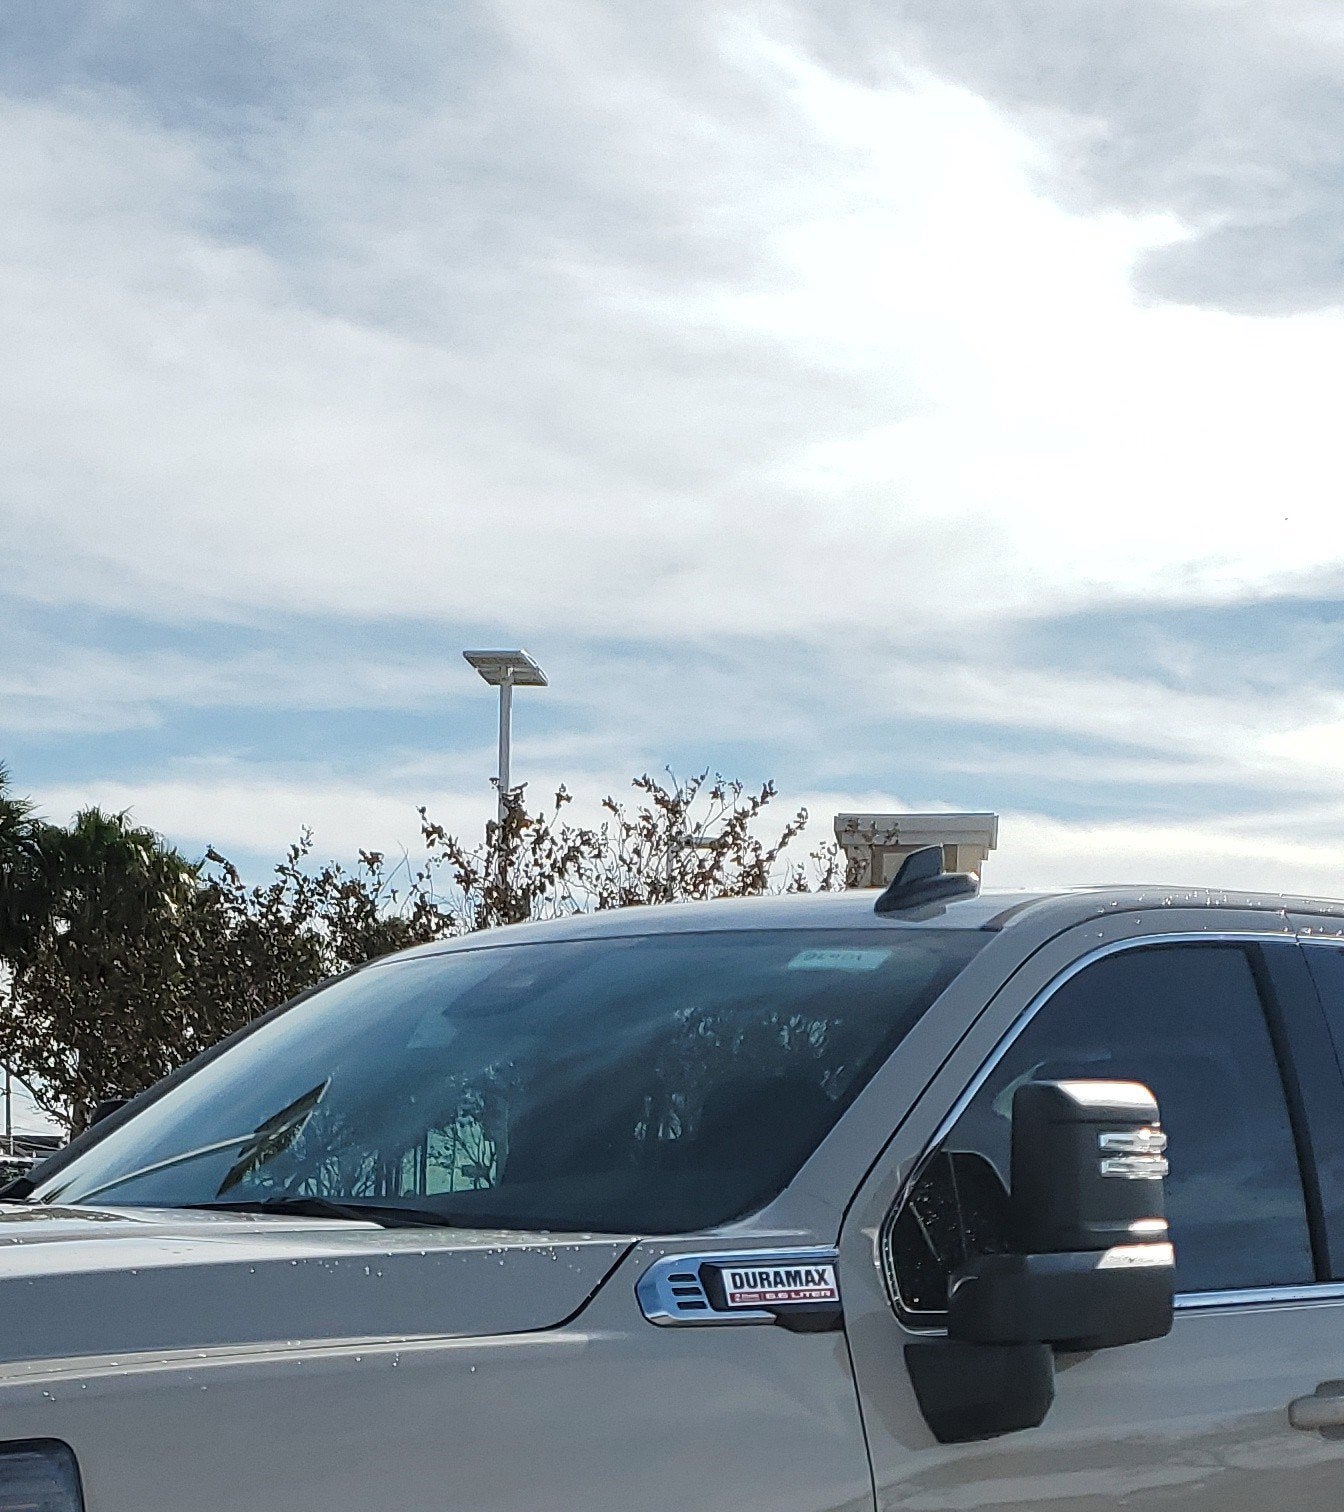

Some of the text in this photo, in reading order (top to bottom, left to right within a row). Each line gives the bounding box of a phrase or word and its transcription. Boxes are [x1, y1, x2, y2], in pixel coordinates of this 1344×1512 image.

[730, 1268, 830, 1290] DURAMAX
[764, 1292, 789, 1301] 6.6
[791, 1289, 832, 1300] LITER
